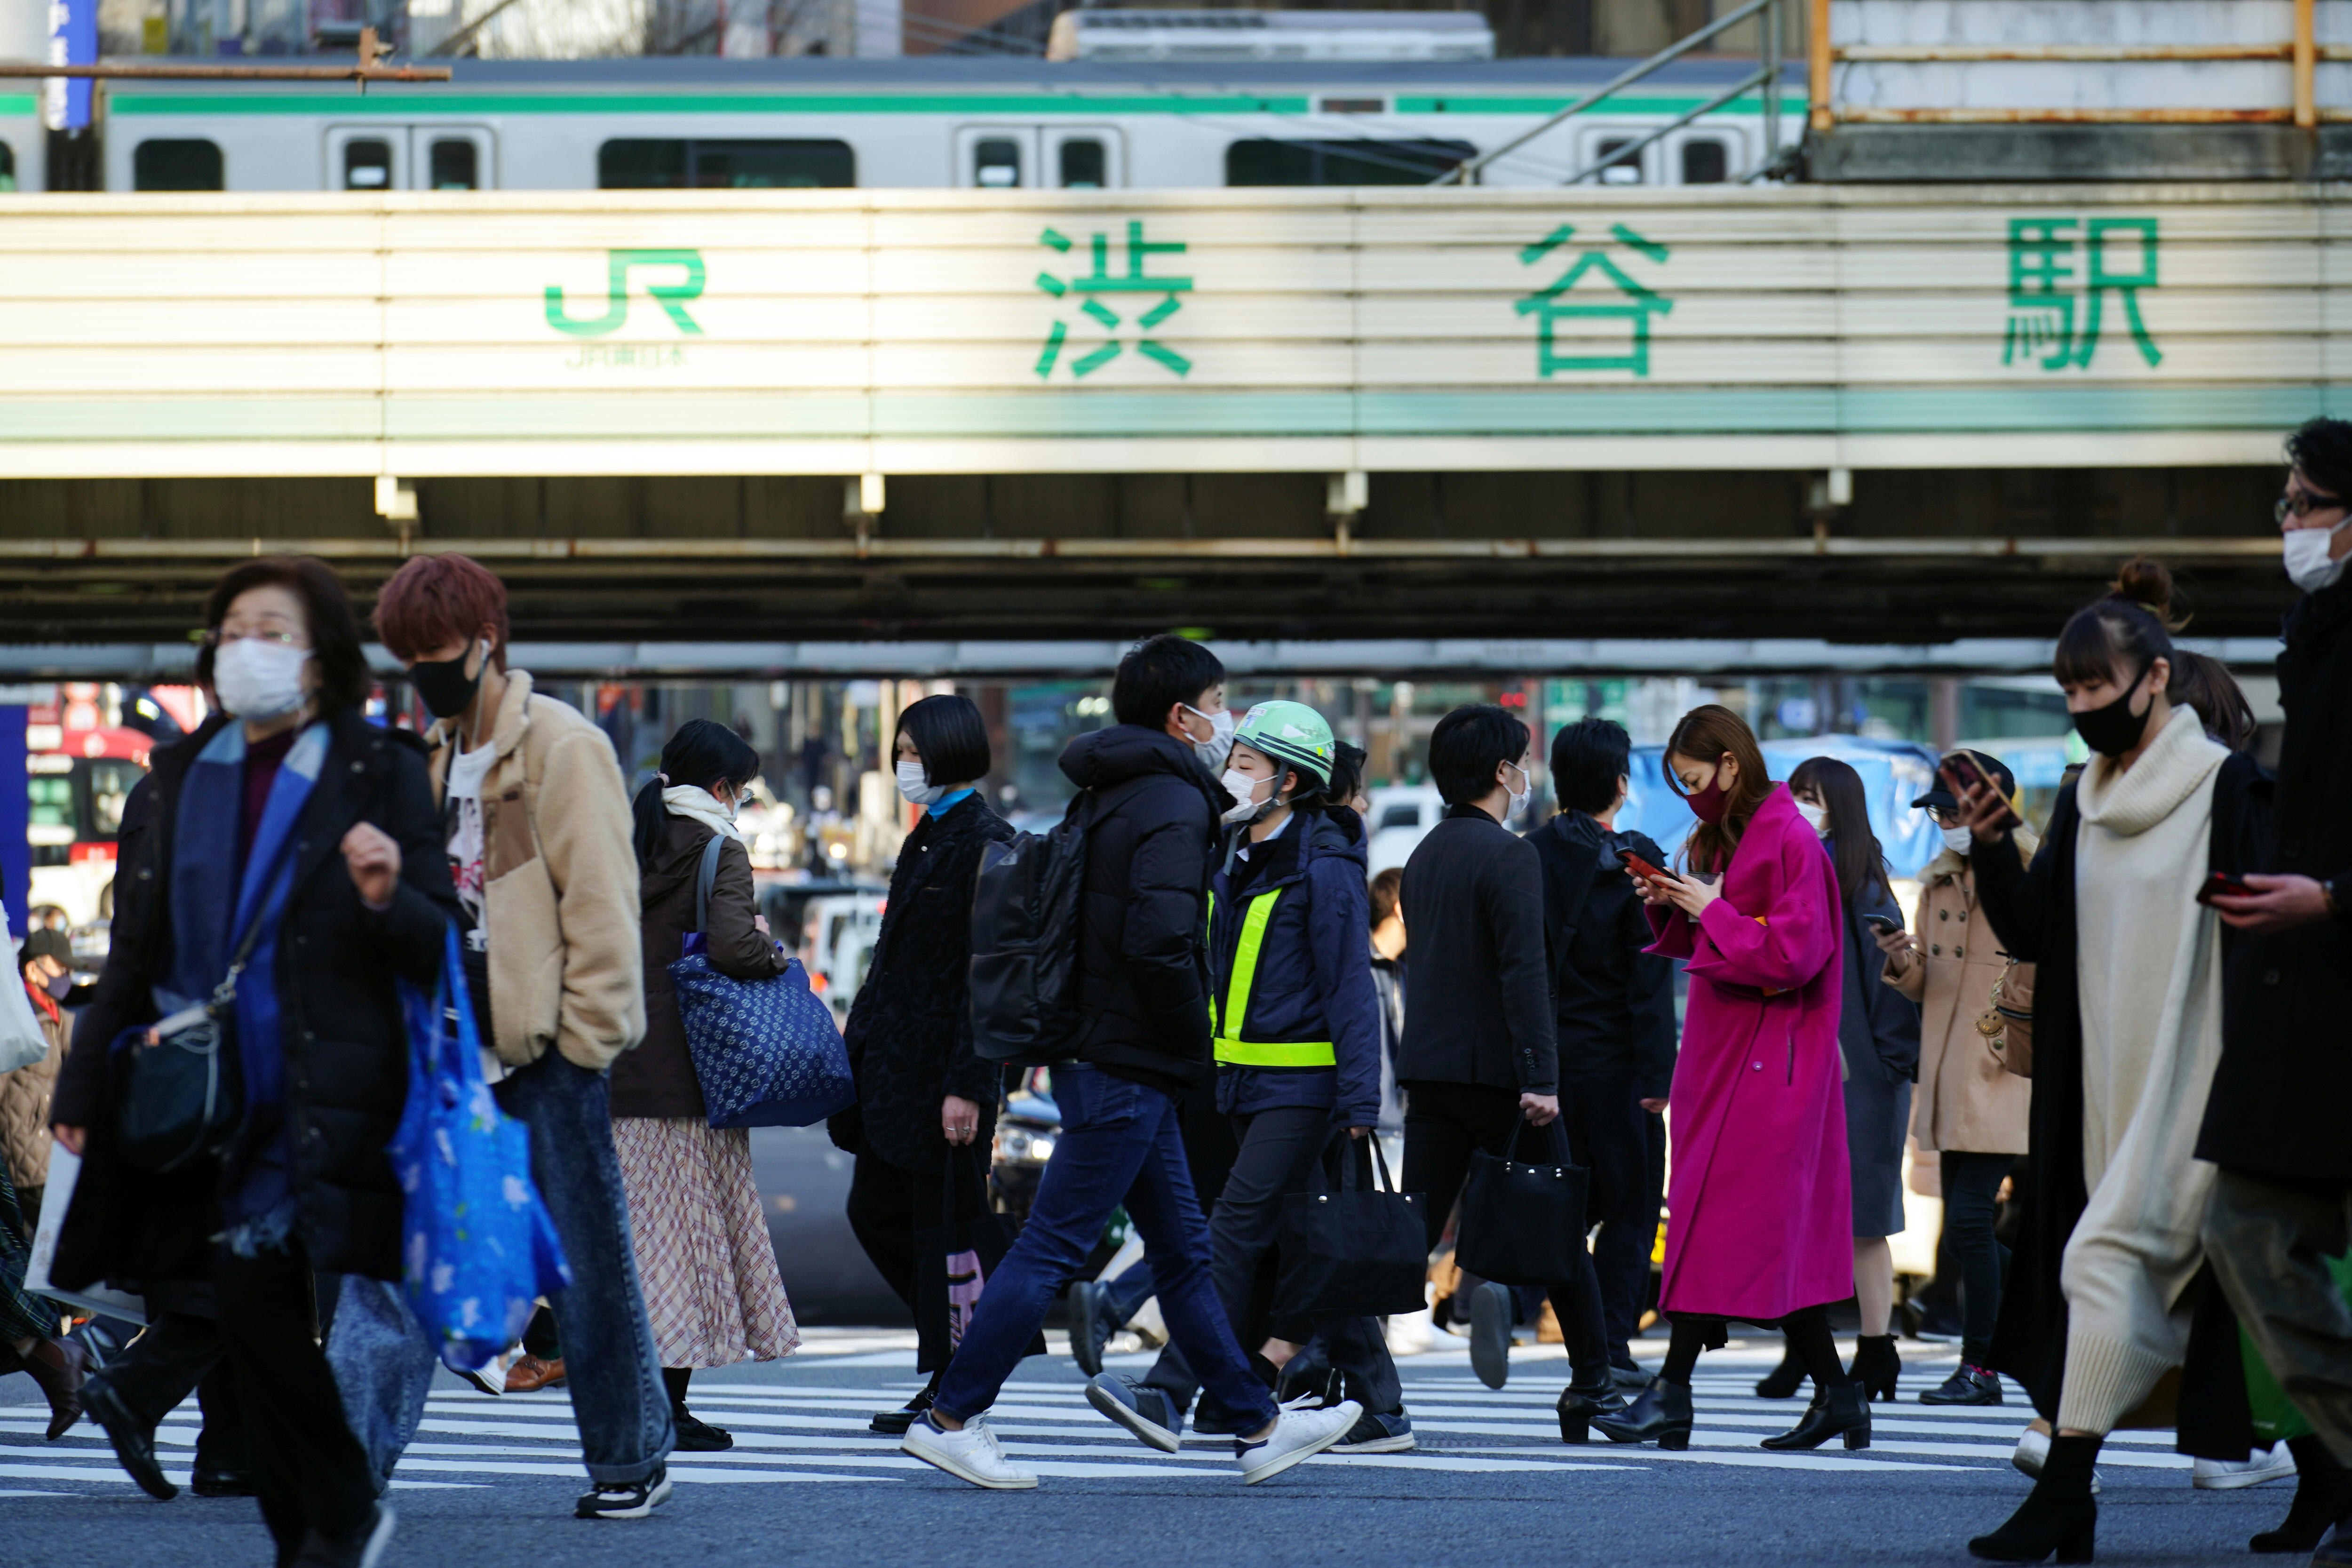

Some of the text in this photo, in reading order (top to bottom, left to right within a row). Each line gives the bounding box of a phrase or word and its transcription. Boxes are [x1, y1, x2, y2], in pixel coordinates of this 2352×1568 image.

[545, 220, 2163, 379] JR 渋谷駅
